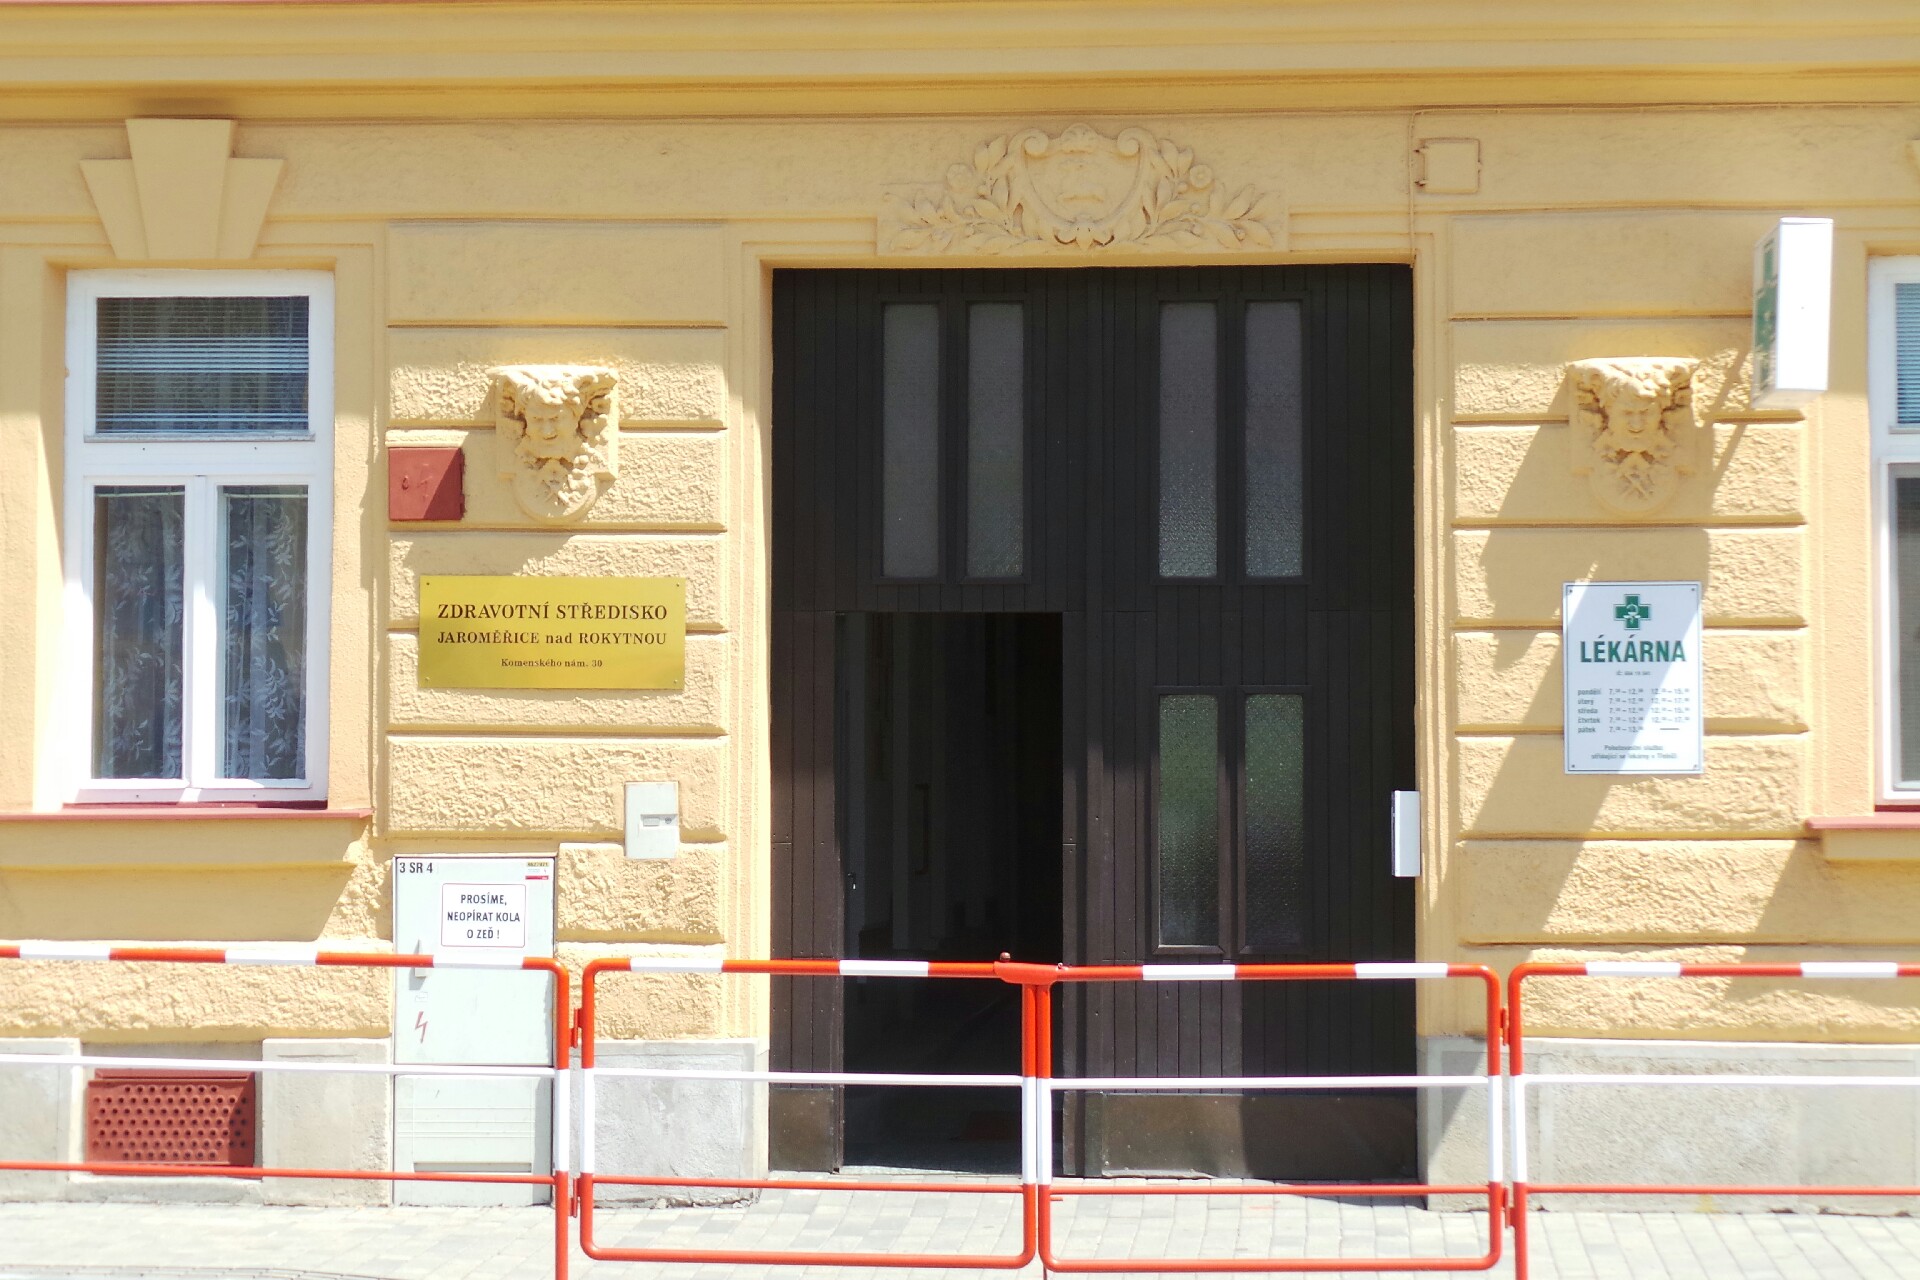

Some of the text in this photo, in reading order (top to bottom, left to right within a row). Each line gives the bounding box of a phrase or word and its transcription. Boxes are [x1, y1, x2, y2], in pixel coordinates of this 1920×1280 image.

[437, 602, 668, 620] ZDRAVOTNÍ STŘEDISKO
[437, 629, 667, 645] JAROMĚŘICE nad ROKYTNOU
[1581, 634, 1686, 662] LÉKÁRNA
[501, 658, 603, 668] Komenského nám. 30
[399, 862, 433, 873] 3 SR 4
[460, 892, 507, 905] PROSÍME,
[447, 909, 520, 922] NEOPÍRAT KOLA
[467, 929, 473, 939] O
